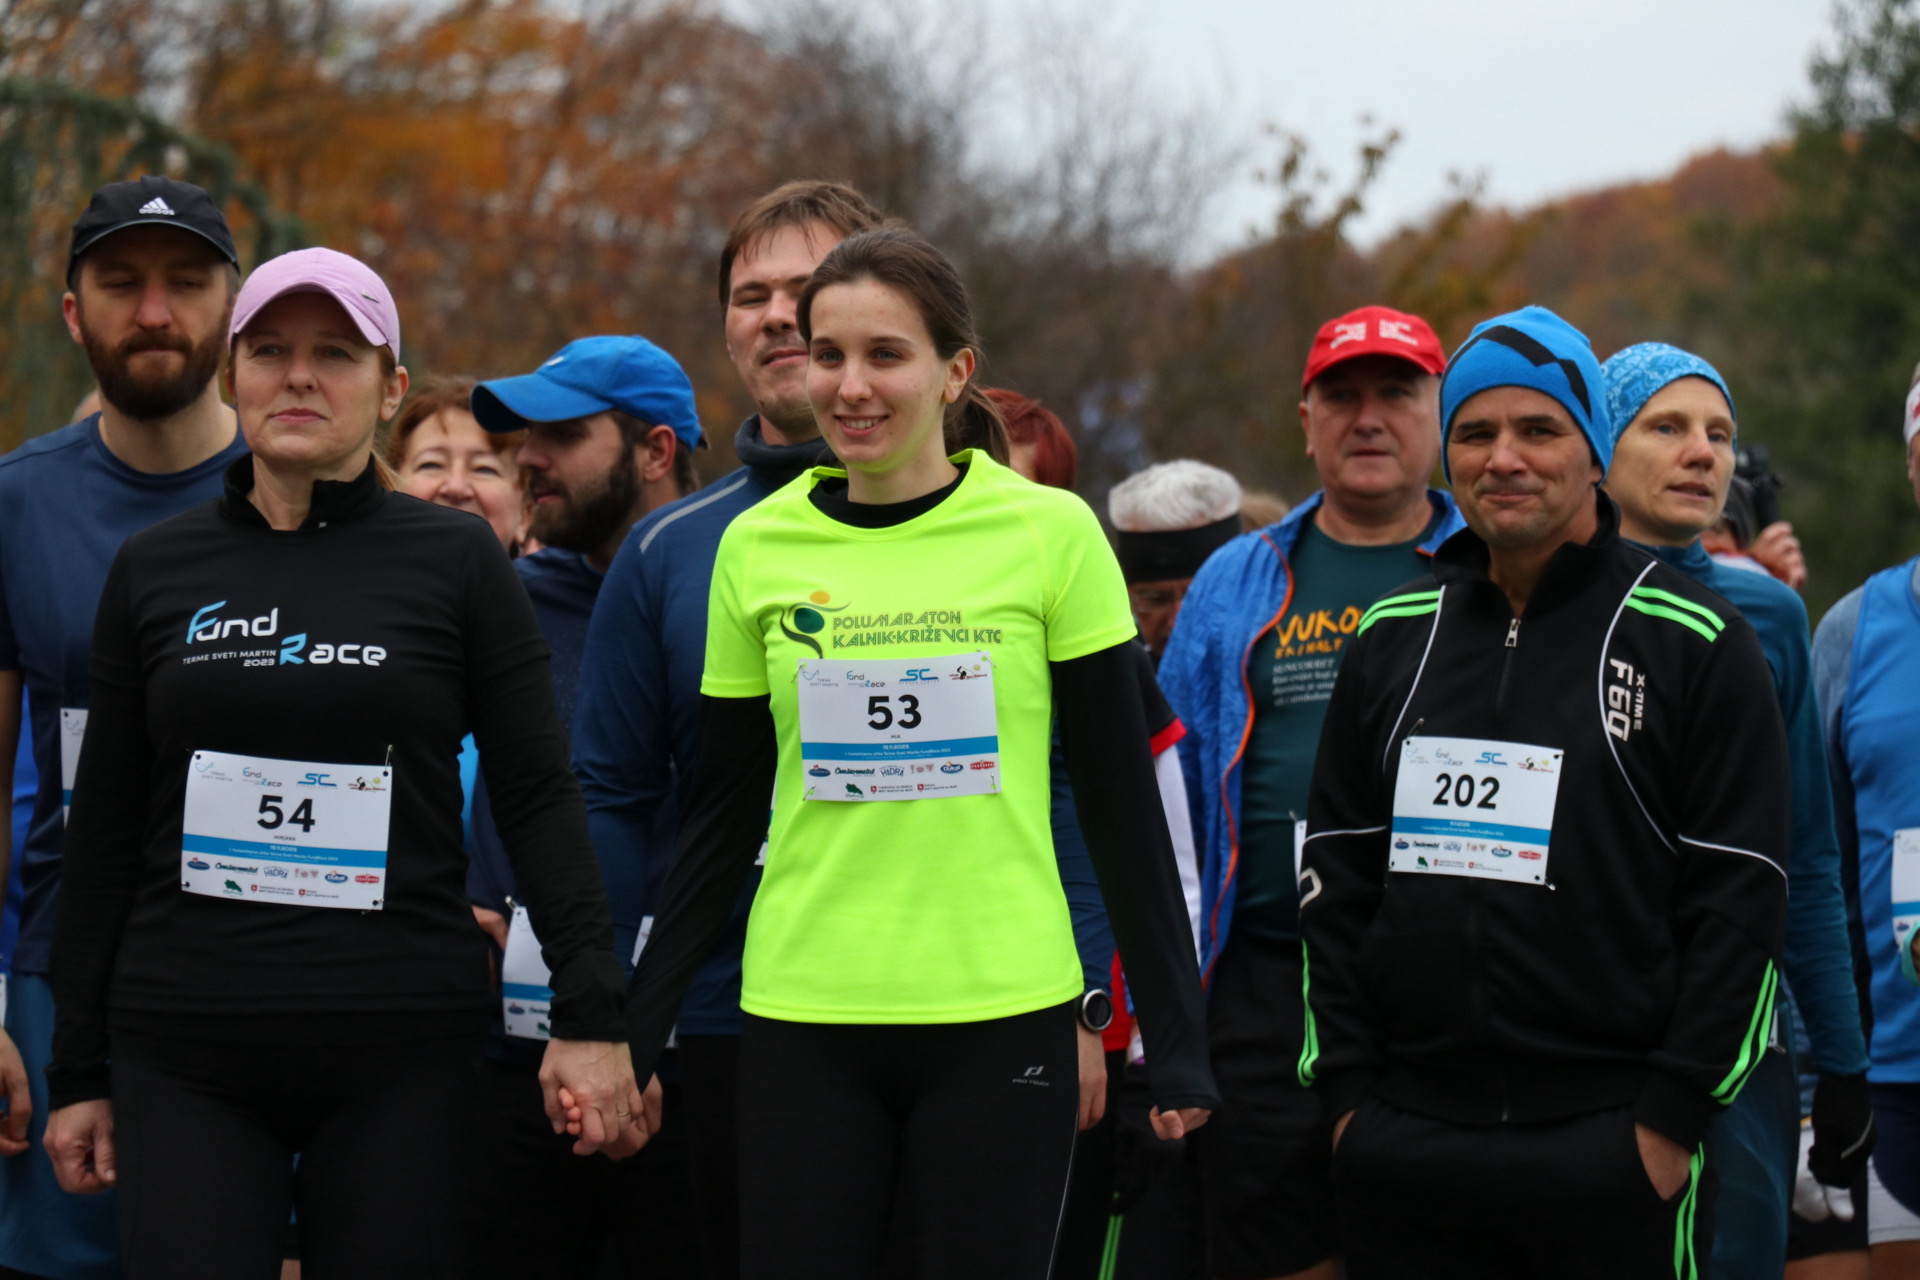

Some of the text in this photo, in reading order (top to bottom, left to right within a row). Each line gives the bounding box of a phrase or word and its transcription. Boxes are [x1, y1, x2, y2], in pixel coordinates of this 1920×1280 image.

[139, 208, 175, 216] adidas
[186, 600, 278, 645] Fund
[832, 610, 961, 631] POLUMARATON
[973, 629, 1001, 644] KTC
[1276, 605, 1364, 647] VUKO
[182, 650, 277, 665] TERME SVETI MARTIN
[243, 658, 276, 667] 2023
[279, 632, 388, 667] Race
[867, 694, 922, 731] 53
[1633, 673, 1646, 731] X-TIME
[1432, 772, 1500, 810] 202
[257, 794, 316, 833] 54
